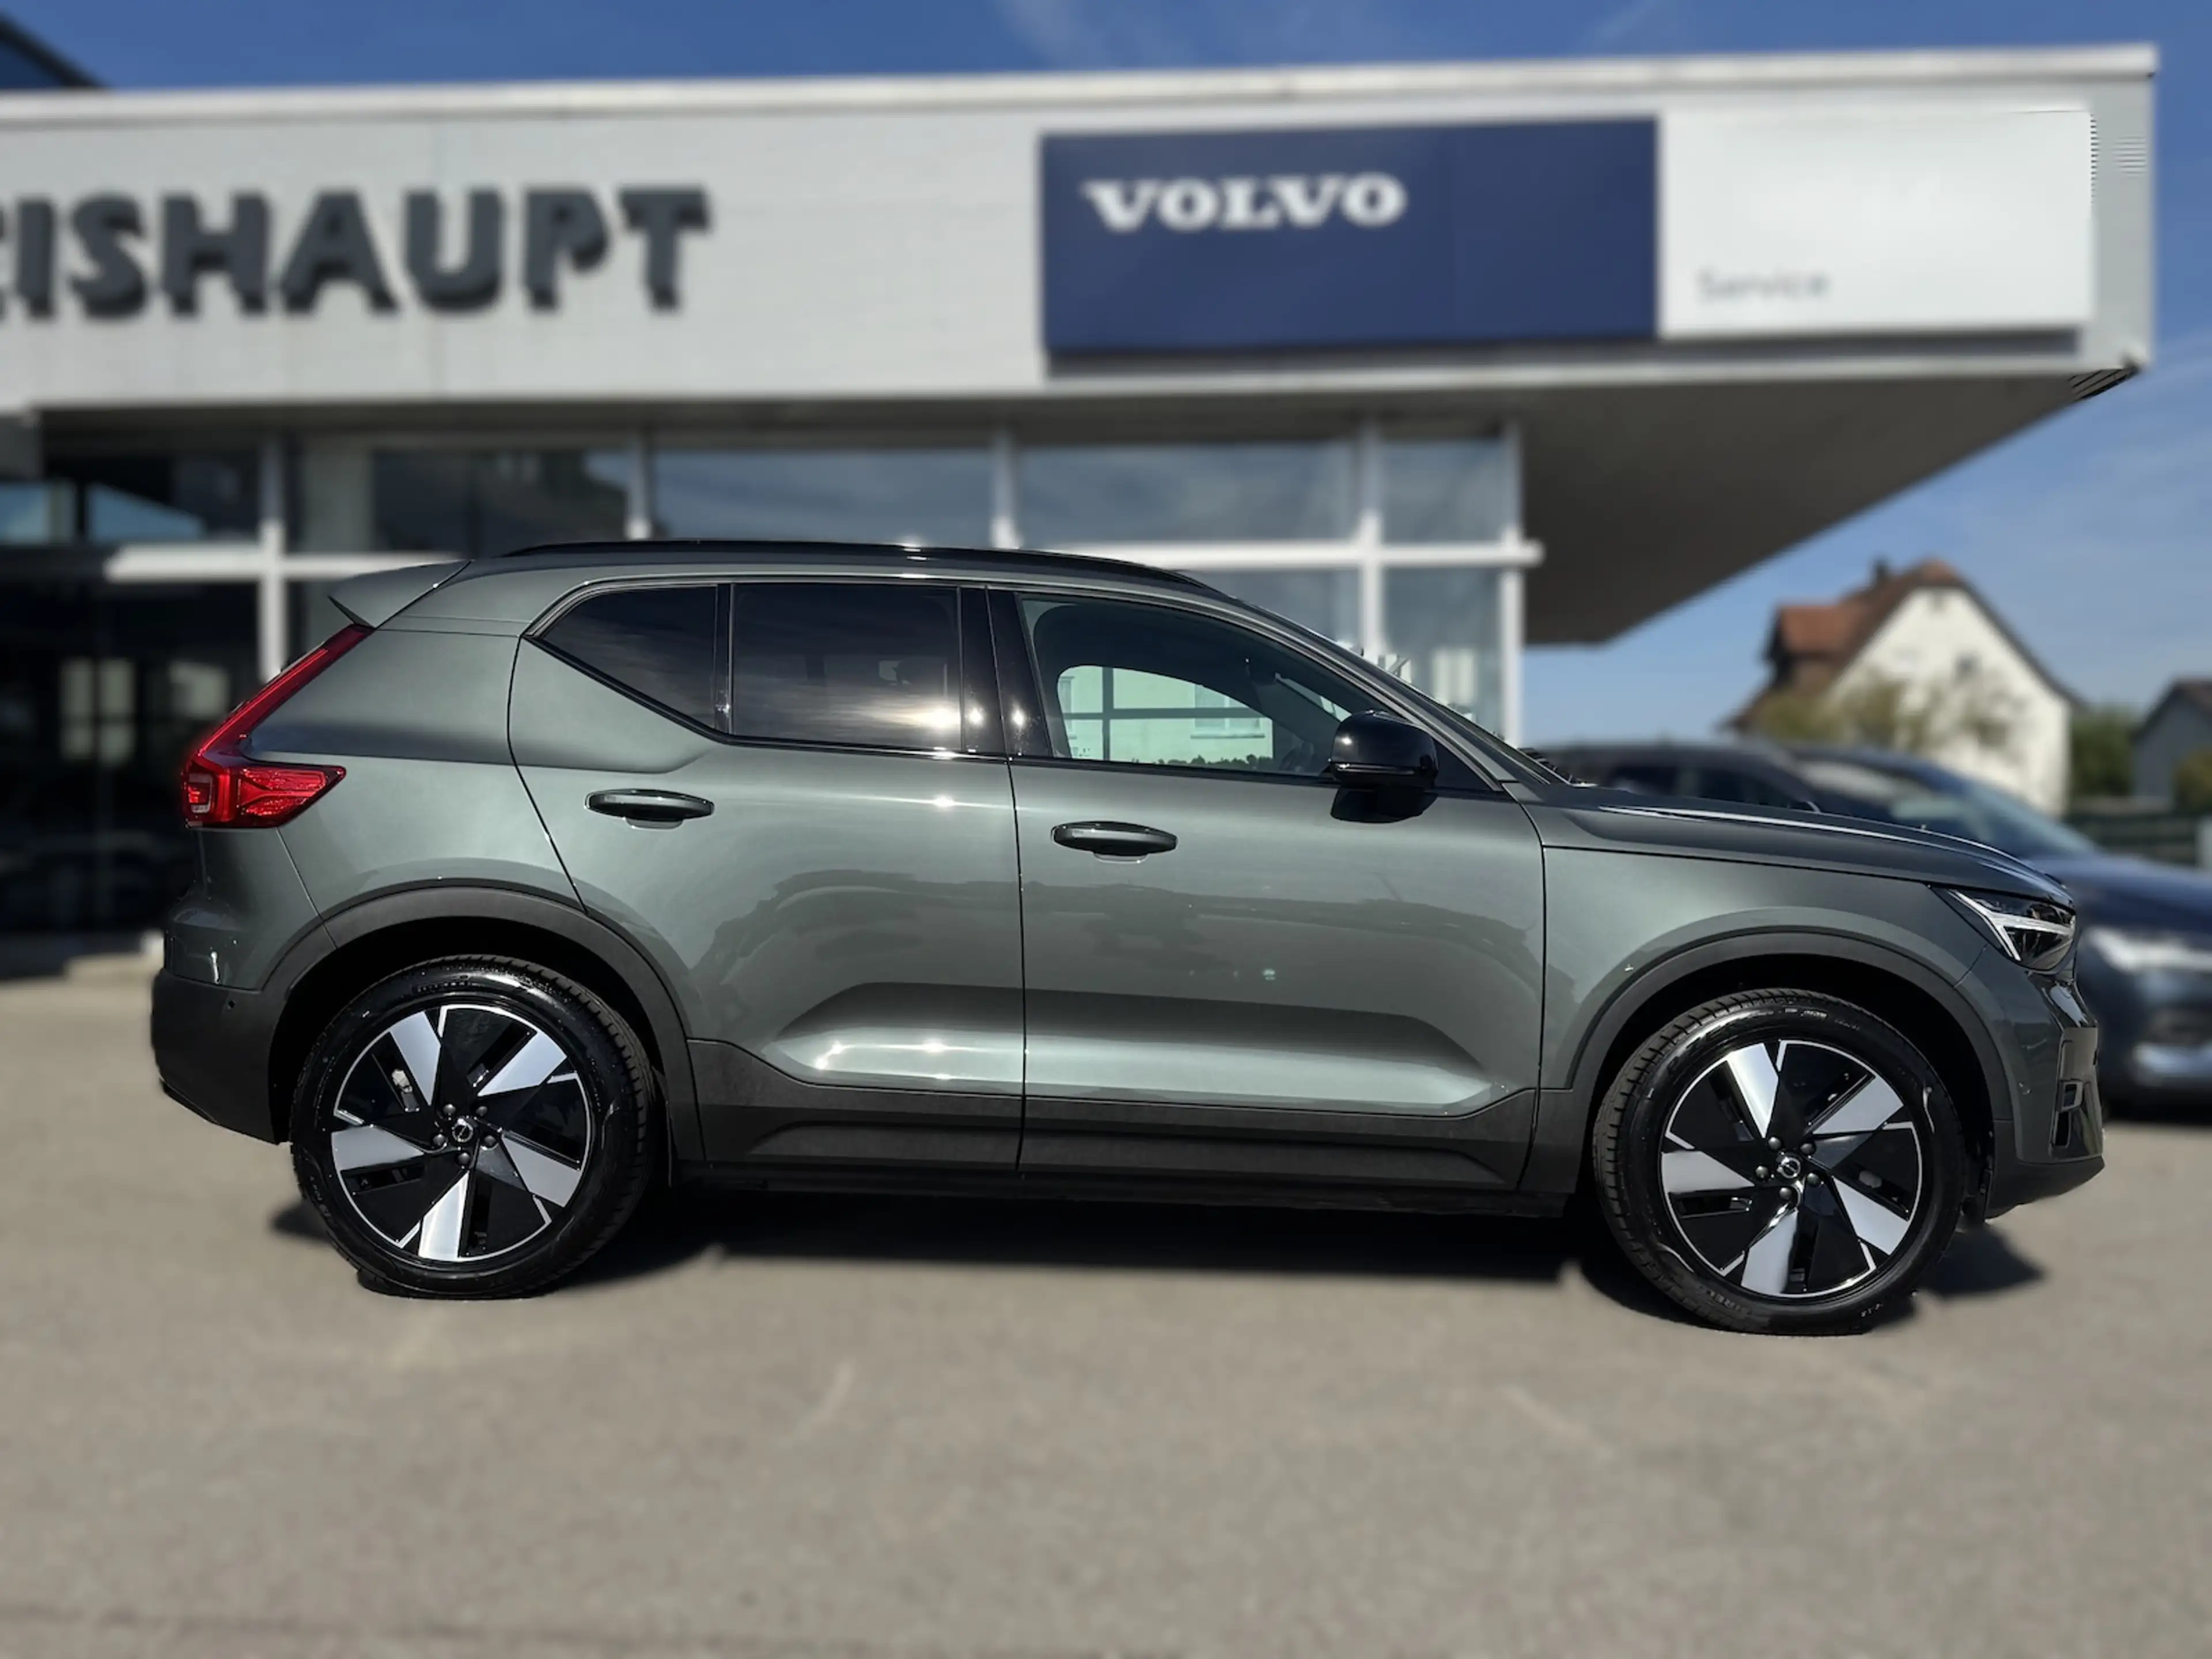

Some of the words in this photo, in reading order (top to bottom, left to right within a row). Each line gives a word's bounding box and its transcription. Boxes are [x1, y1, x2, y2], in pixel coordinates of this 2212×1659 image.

[1082, 173, 1407, 231] VOLVO
[0, 188, 711, 323] ISHAUPT
[1696, 266, 1831, 303] Service
